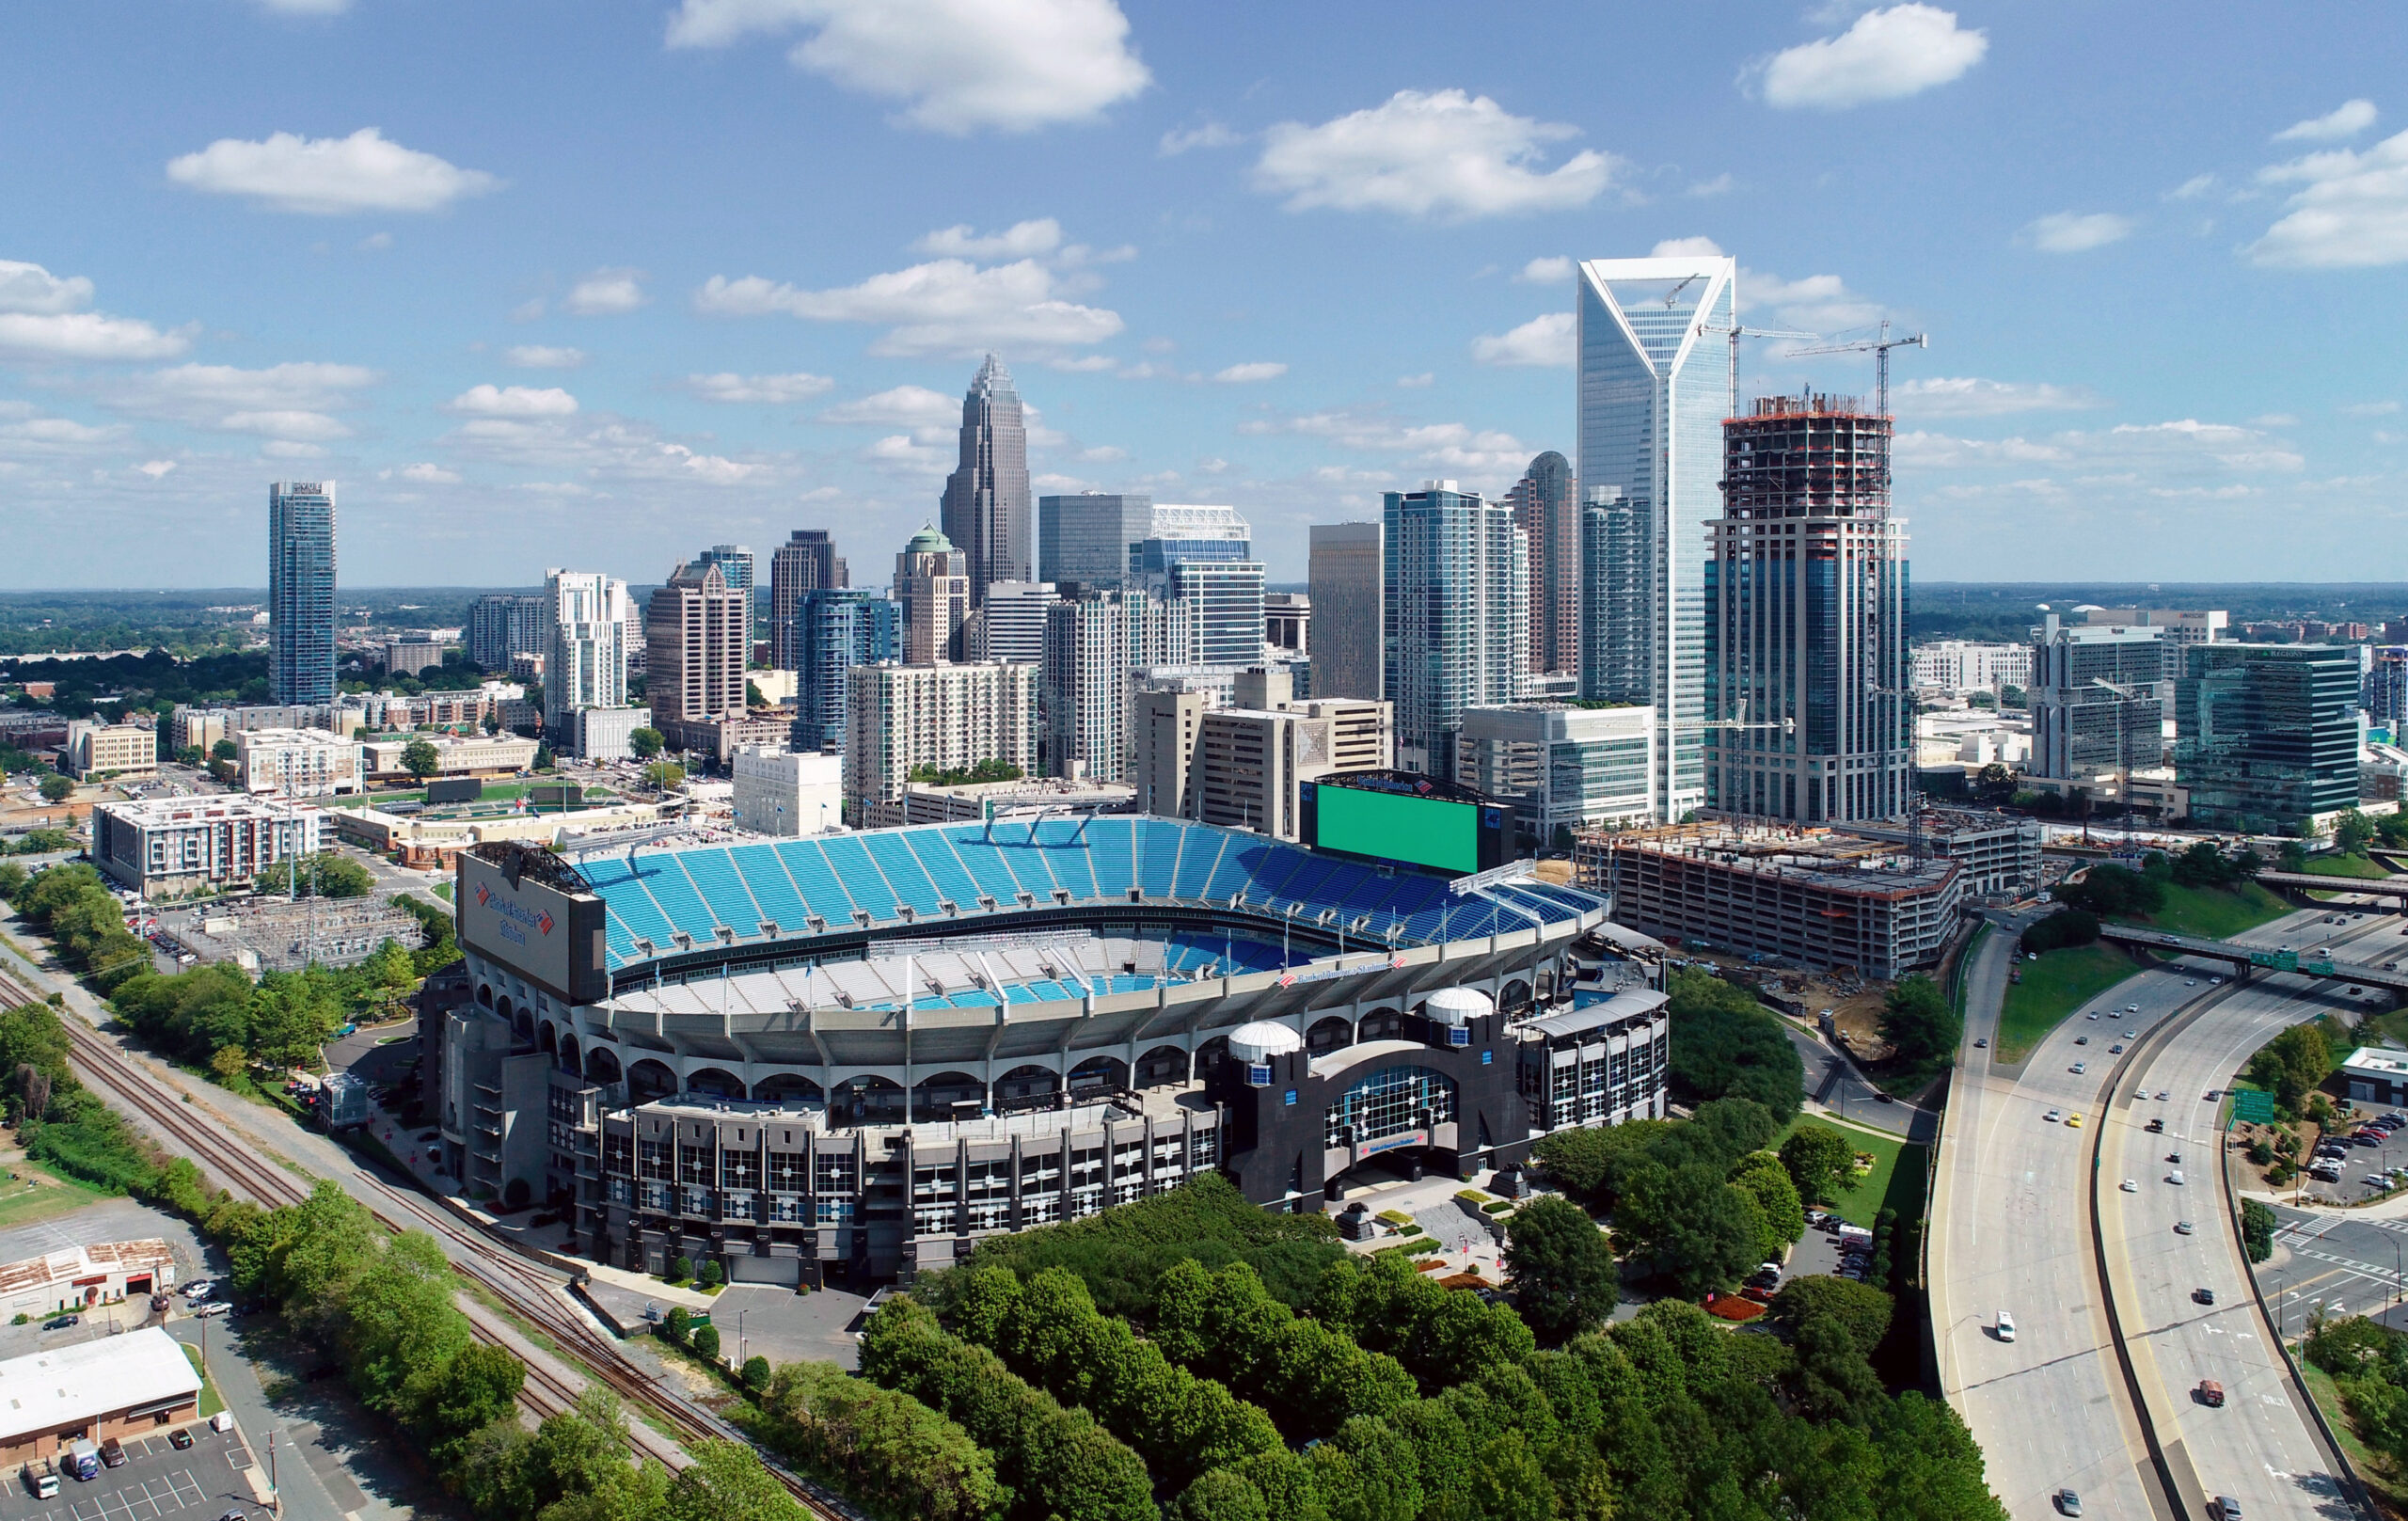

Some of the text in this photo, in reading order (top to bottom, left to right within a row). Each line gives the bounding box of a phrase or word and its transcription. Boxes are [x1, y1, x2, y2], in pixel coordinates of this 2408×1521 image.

[1298, 973, 1317, 984] Bank
[1327, 968, 1356, 978] America
[1357, 963, 1387, 974] Stadium
[2262, 1394, 2286, 1406] ONLY
